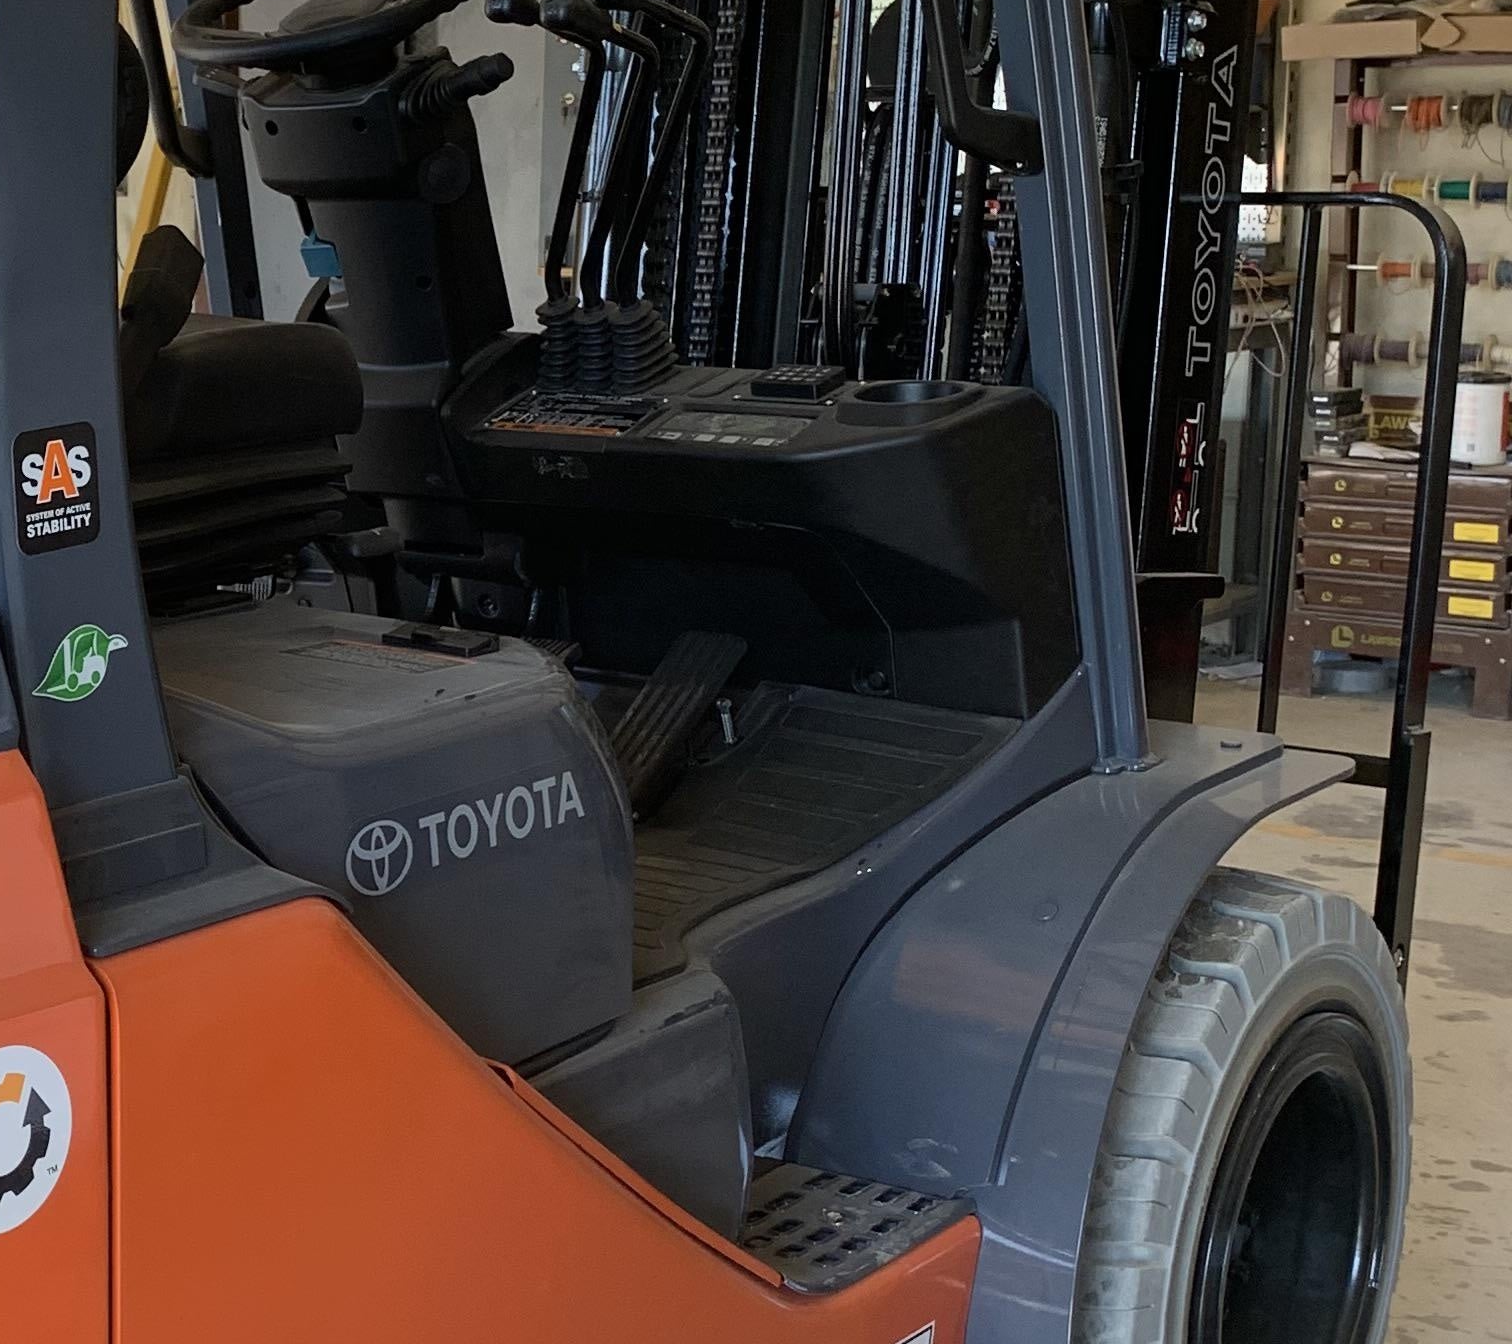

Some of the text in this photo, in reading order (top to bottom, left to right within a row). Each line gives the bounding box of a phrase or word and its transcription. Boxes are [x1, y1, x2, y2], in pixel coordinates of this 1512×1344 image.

[1185, 46, 1238, 377] TOYOTA
[21, 439, 92, 505] SAS
[26, 502, 91, 523] SYSTEM OF ACTIVE
[26, 513, 92, 538] STABILITY
[418, 770, 585, 868] TOYOTA
